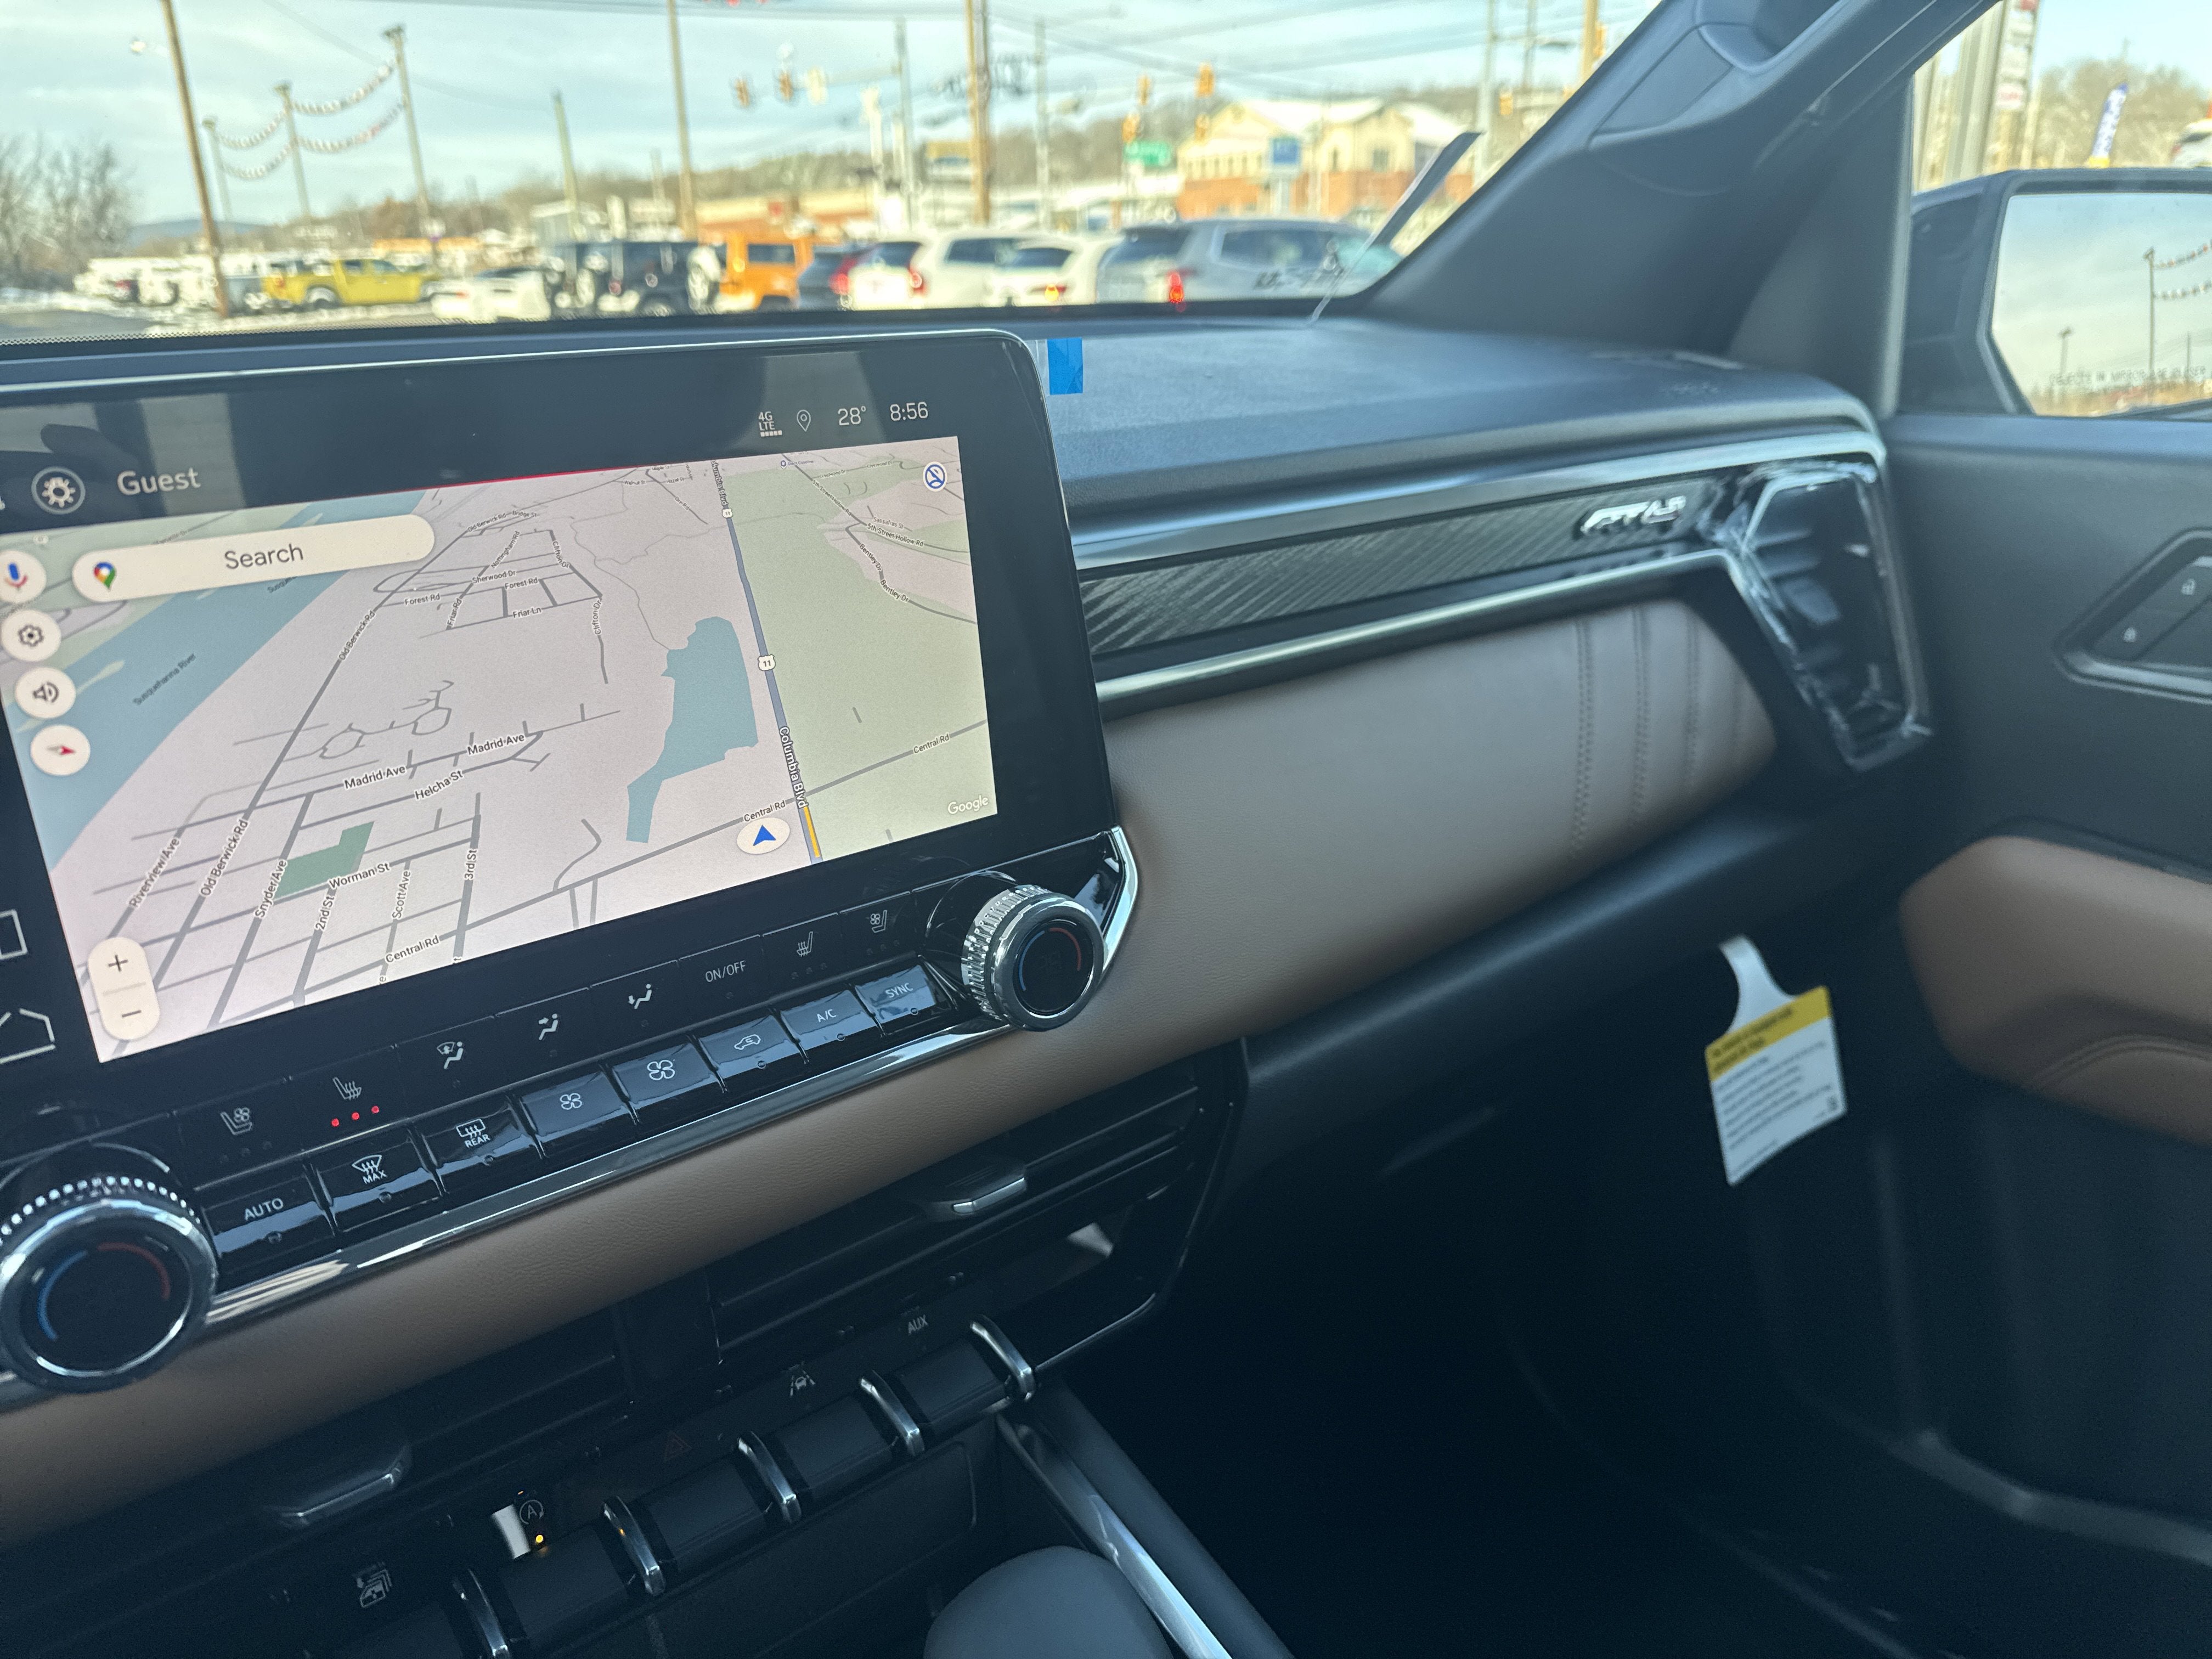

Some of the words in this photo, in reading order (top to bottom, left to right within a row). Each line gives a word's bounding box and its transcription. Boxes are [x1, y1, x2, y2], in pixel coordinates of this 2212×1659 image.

[758, 411, 773, 421] 4G
[889, 402, 928, 421] 8:56
[759, 421, 776, 431] LTE
[117, 467, 201, 495] Guest
[718, 489, 728, 505] Blvd
[867, 523, 877, 532] 5th
[878, 528, 894, 539] Street
[895, 534, 915, 545] Hollow
[224, 543, 304, 569] Search
[552, 541, 562, 564] Clifton
[860, 544, 877, 565] Bentley
[876, 563, 882, 572] Dr
[472, 571, 507, 584] Sherwood
[504, 580, 527, 590] Forest
[404, 596, 428, 605] Forest
[430, 592, 441, 601] Rd
[880, 580, 901, 600] Bentley
[901, 594, 909, 602] Dr
[447, 607, 459, 626] Friar
[453, 597, 462, 610] Rd
[512, 608, 531, 618] Friar
[594, 599, 602, 609] Dr
[591, 610, 601, 635] Clifton
[338, 648, 350, 661] Old
[346, 621, 366, 648] Berwick
[364, 610, 375, 621] Rd
[467, 741, 504, 755] Madrid
[506, 734, 525, 745] Ave
[913, 738, 938, 754] Central
[939, 733, 950, 742] Rd
[344, 773, 383, 789] Madrid
[386, 765, 406, 778] Ave
[779, 726, 800, 782] Columbia
[793, 782, 809, 809] Blvd
[415, 778, 450, 800] Helcha
[450, 770, 463, 781] St
[743, 805, 773, 822] Central
[774, 799, 786, 810] Rd
[947, 794, 989, 815] Google
[200, 878, 217, 897] Old
[211, 837, 239, 878] Berwick
[233, 819, 249, 836] Rd
[467, 849, 477, 860] St
[129, 860, 167, 907] Riverview
[162, 838, 180, 860] Ave
[329, 869, 375, 889] Worman
[377, 862, 391, 873] St
[399, 871, 411, 890] Ave
[465, 862, 475, 879] 3rd
[255, 882, 276, 918] Snyder
[271, 859, 287, 882] Ave
[315, 909, 330, 930] 2nd
[323, 895, 335, 907] St
[392, 891, 407, 918] Scott
[385, 941, 424, 963] Central
[425, 935, 439, 946] Rd
[705, 960, 747, 983] ON/OFF
[885, 983, 914, 998] SYNC
[816, 1008, 837, 1023] A/C
[464, 1133, 491, 1148] REAR
[362, 1169, 388, 1184] MAX
[243, 1197, 284, 1221] AUTO
[907, 1314, 929, 1335] AUX
